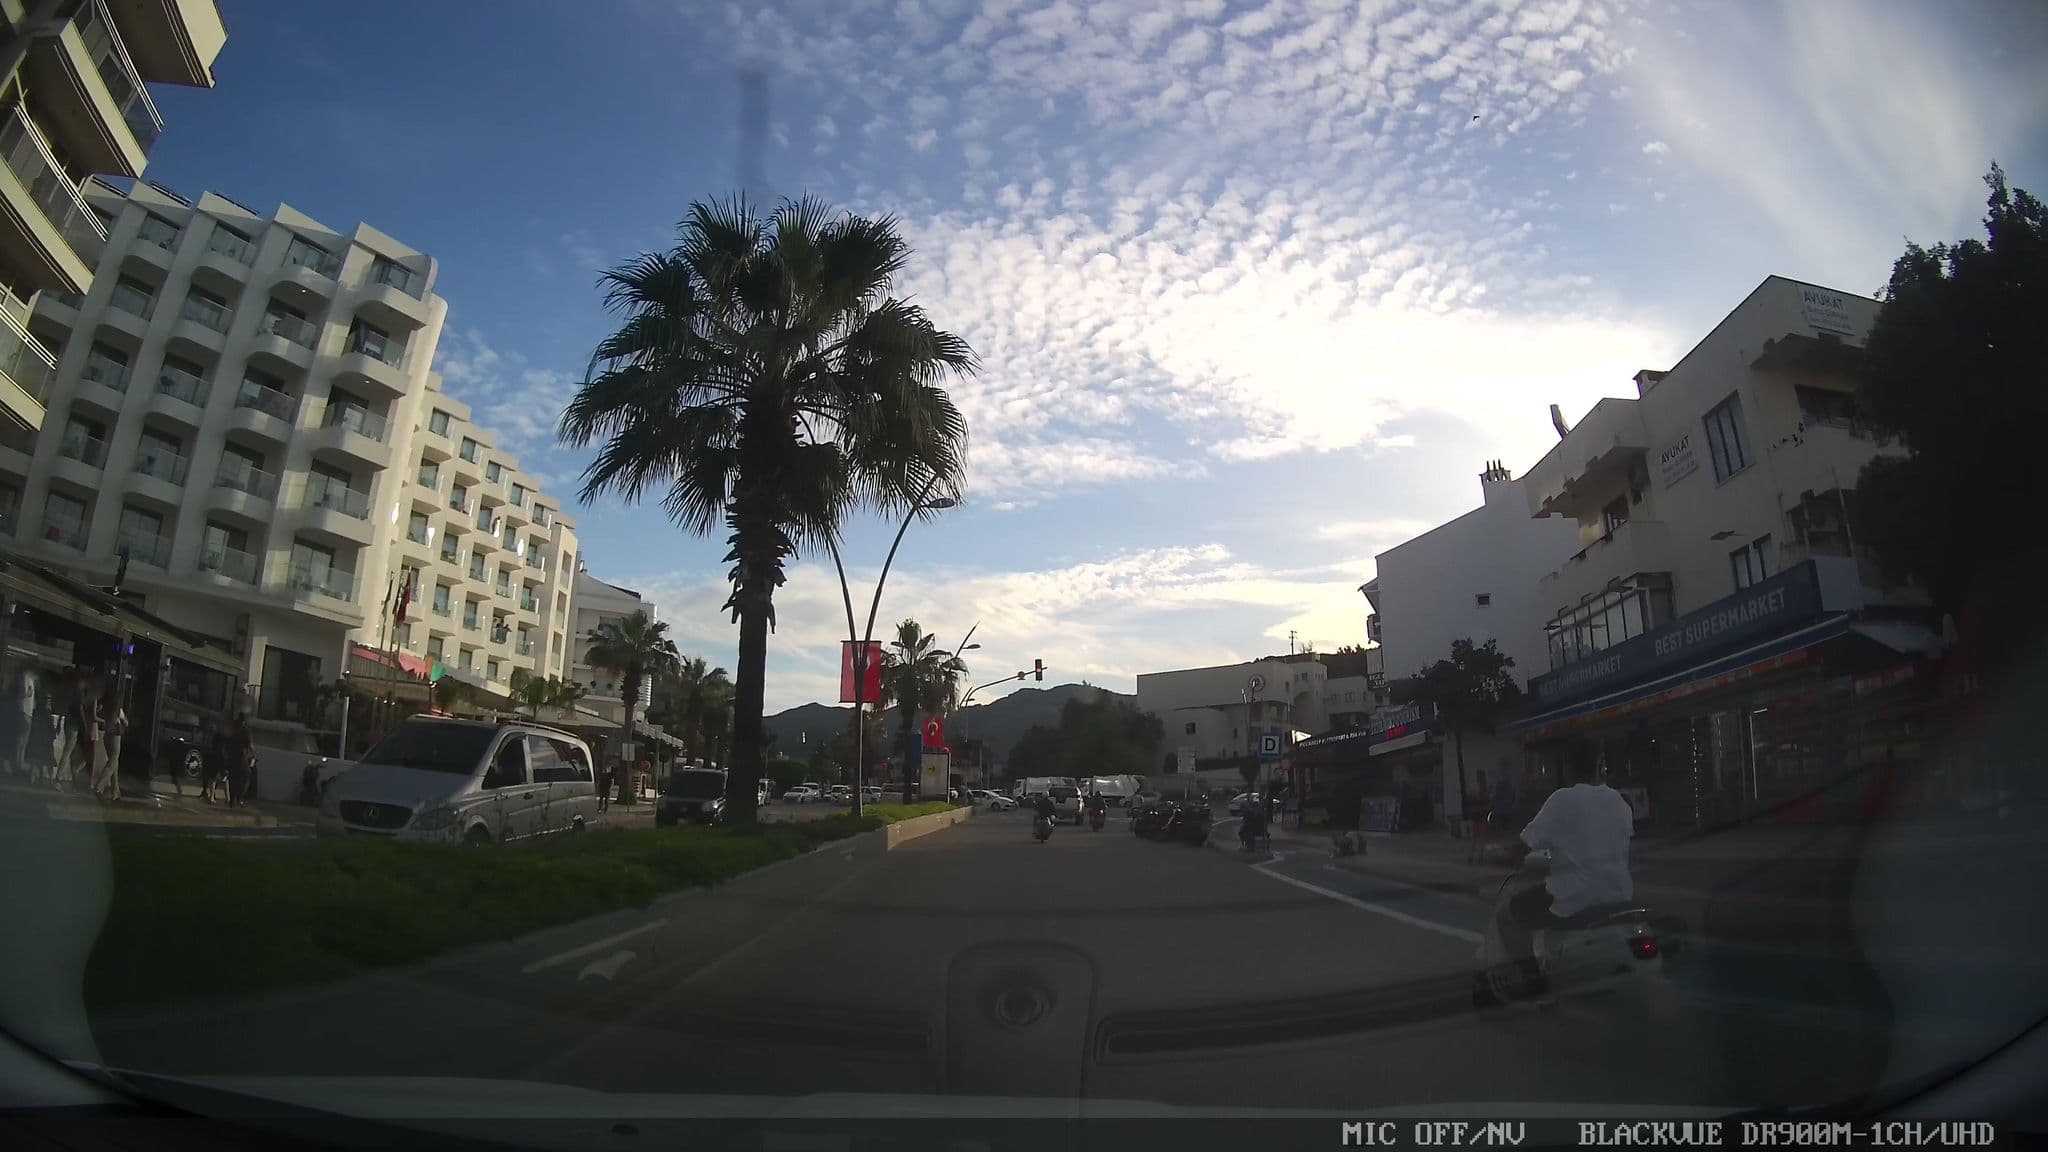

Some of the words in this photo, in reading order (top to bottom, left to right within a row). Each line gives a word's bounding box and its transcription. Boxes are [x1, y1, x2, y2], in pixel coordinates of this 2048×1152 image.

[1661, 434, 1689, 464] AVUKAT
[1655, 630, 1682, 657] BEST
[1686, 588, 1785, 643] SUPERMARKET
[1265, 738, 1275, 751] D
